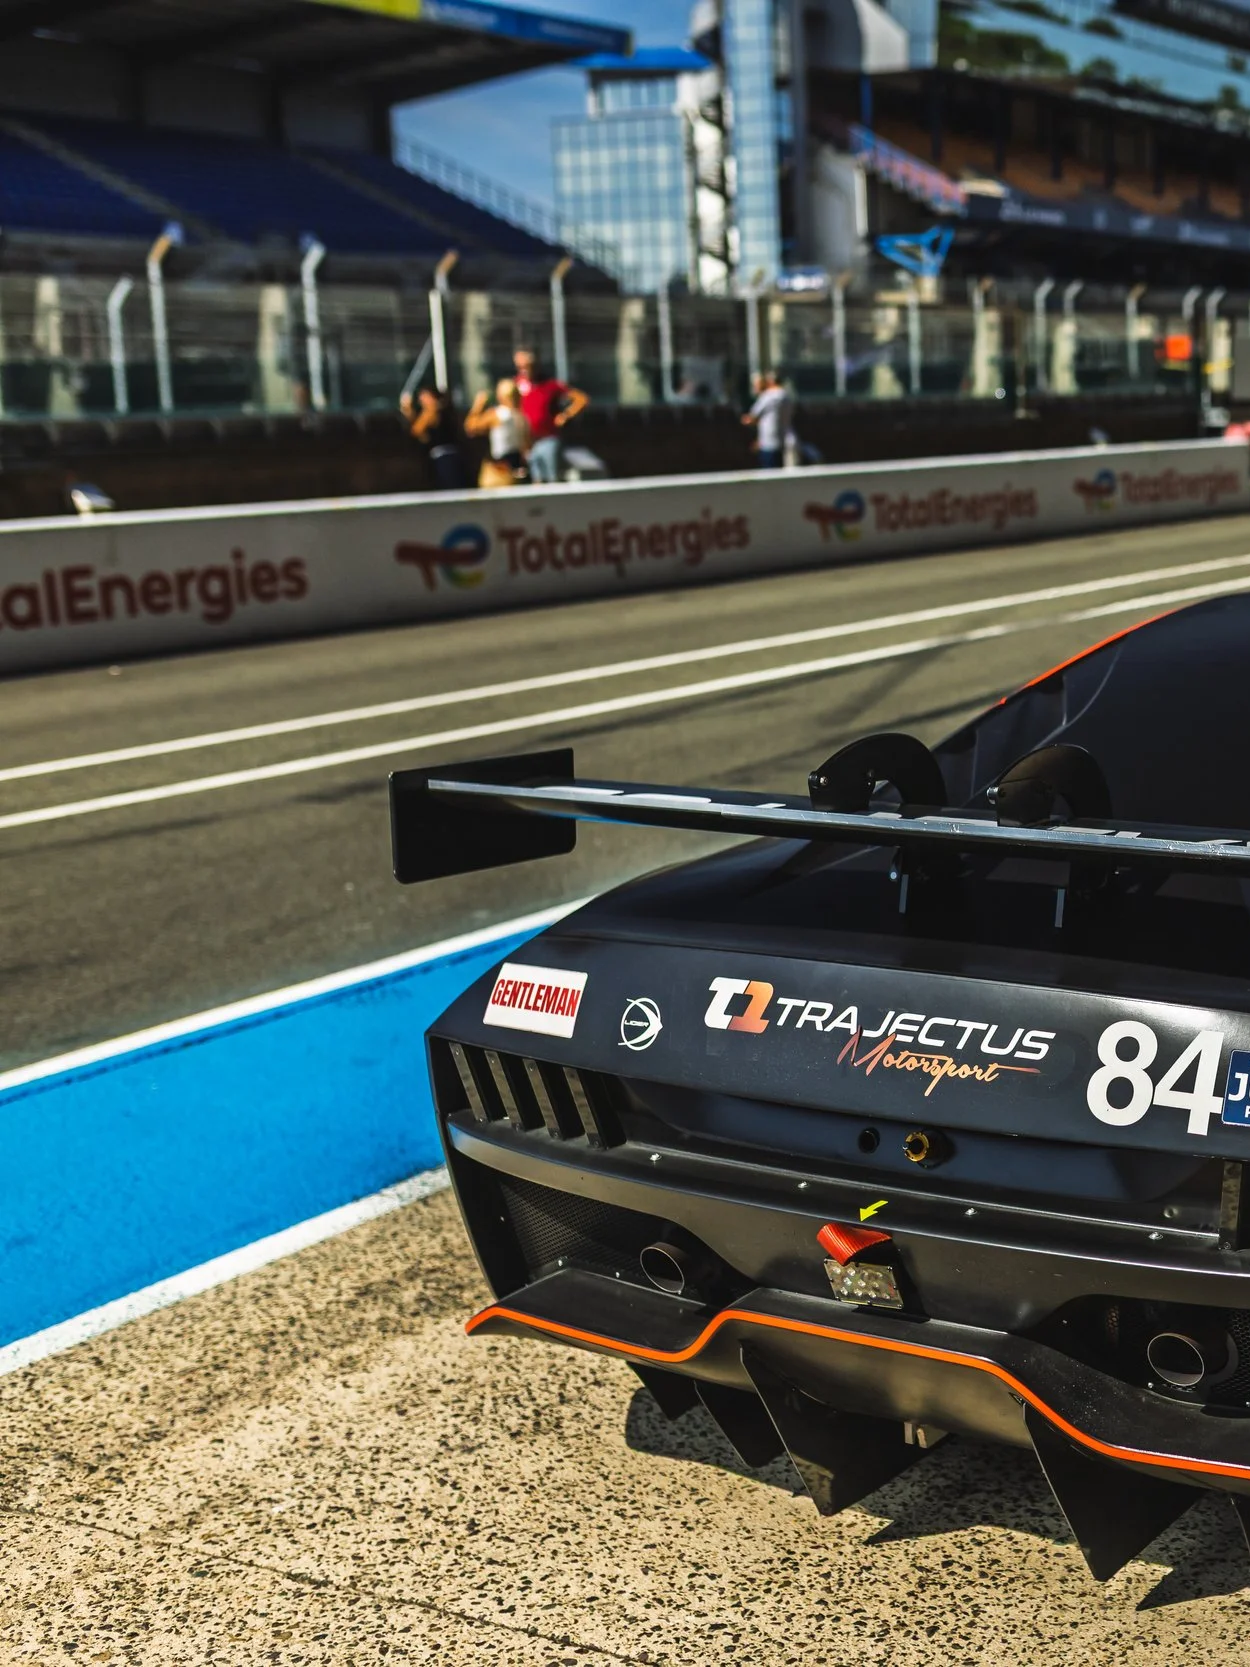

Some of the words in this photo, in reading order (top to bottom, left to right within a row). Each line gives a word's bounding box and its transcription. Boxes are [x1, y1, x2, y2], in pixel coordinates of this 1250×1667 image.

[497, 507, 750, 575] TotalEnergies
[0, 547, 309, 631] alEnergies
[491, 979, 581, 1017] GENTLEMAN
[776, 997, 1056, 1061] TRAJECTUS
[837, 1026, 1041, 1097] Motorsport
[1086, 1020, 1225, 1136] 84
